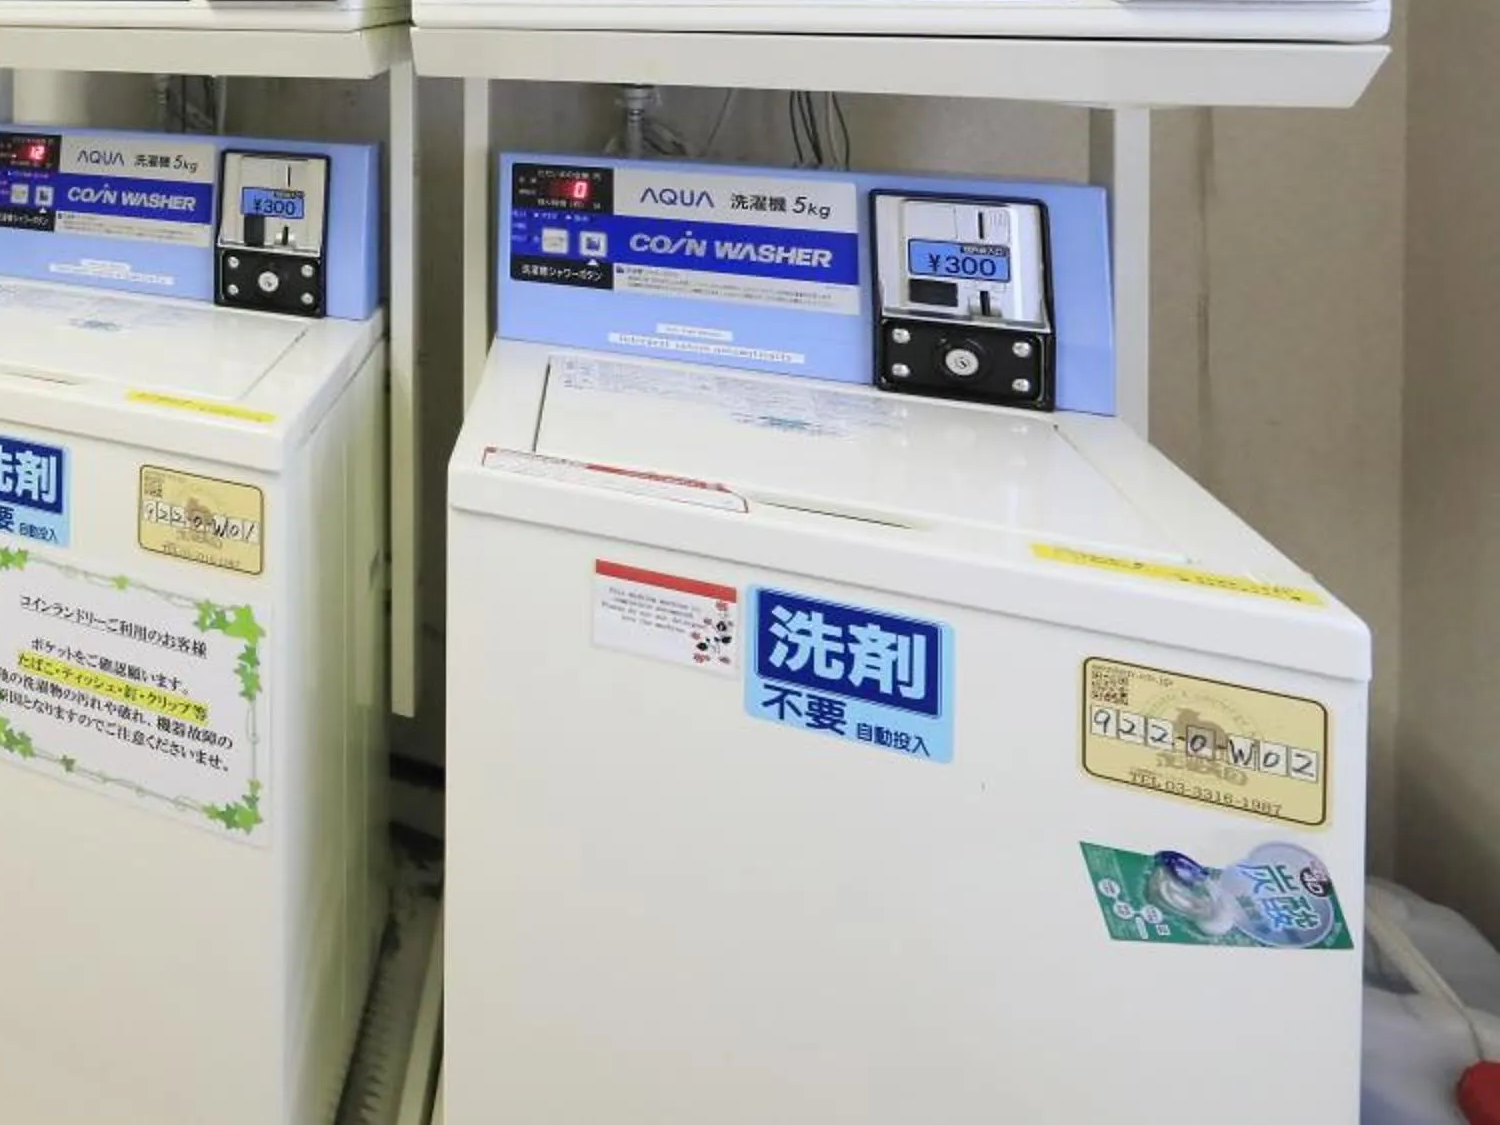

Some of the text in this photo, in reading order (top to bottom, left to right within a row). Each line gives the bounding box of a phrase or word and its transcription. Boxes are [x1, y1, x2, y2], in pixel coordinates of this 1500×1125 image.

[77, 150, 125, 167] AQUA
[172, 155, 198, 173] 5kg
[121, 190, 197, 212] WASHER
[573, 180, 588, 200] 0
[639, 186, 831, 220] AQUA 洗濯機 5kg
[252, 197, 298, 216] ¥300
[713, 239, 834, 268] WASHER
[927, 252, 997, 276] ¥300
[18, 521, 59, 543] 自動投入
[20, 593, 209, 659] コインランドリーご利用のお客様
[31, 637, 190, 695] ポケットをご確認願います。
[768, 603, 927, 700] 洗剤
[761, 683, 847, 736] 不要
[856, 723, 931, 758] 自動投入
